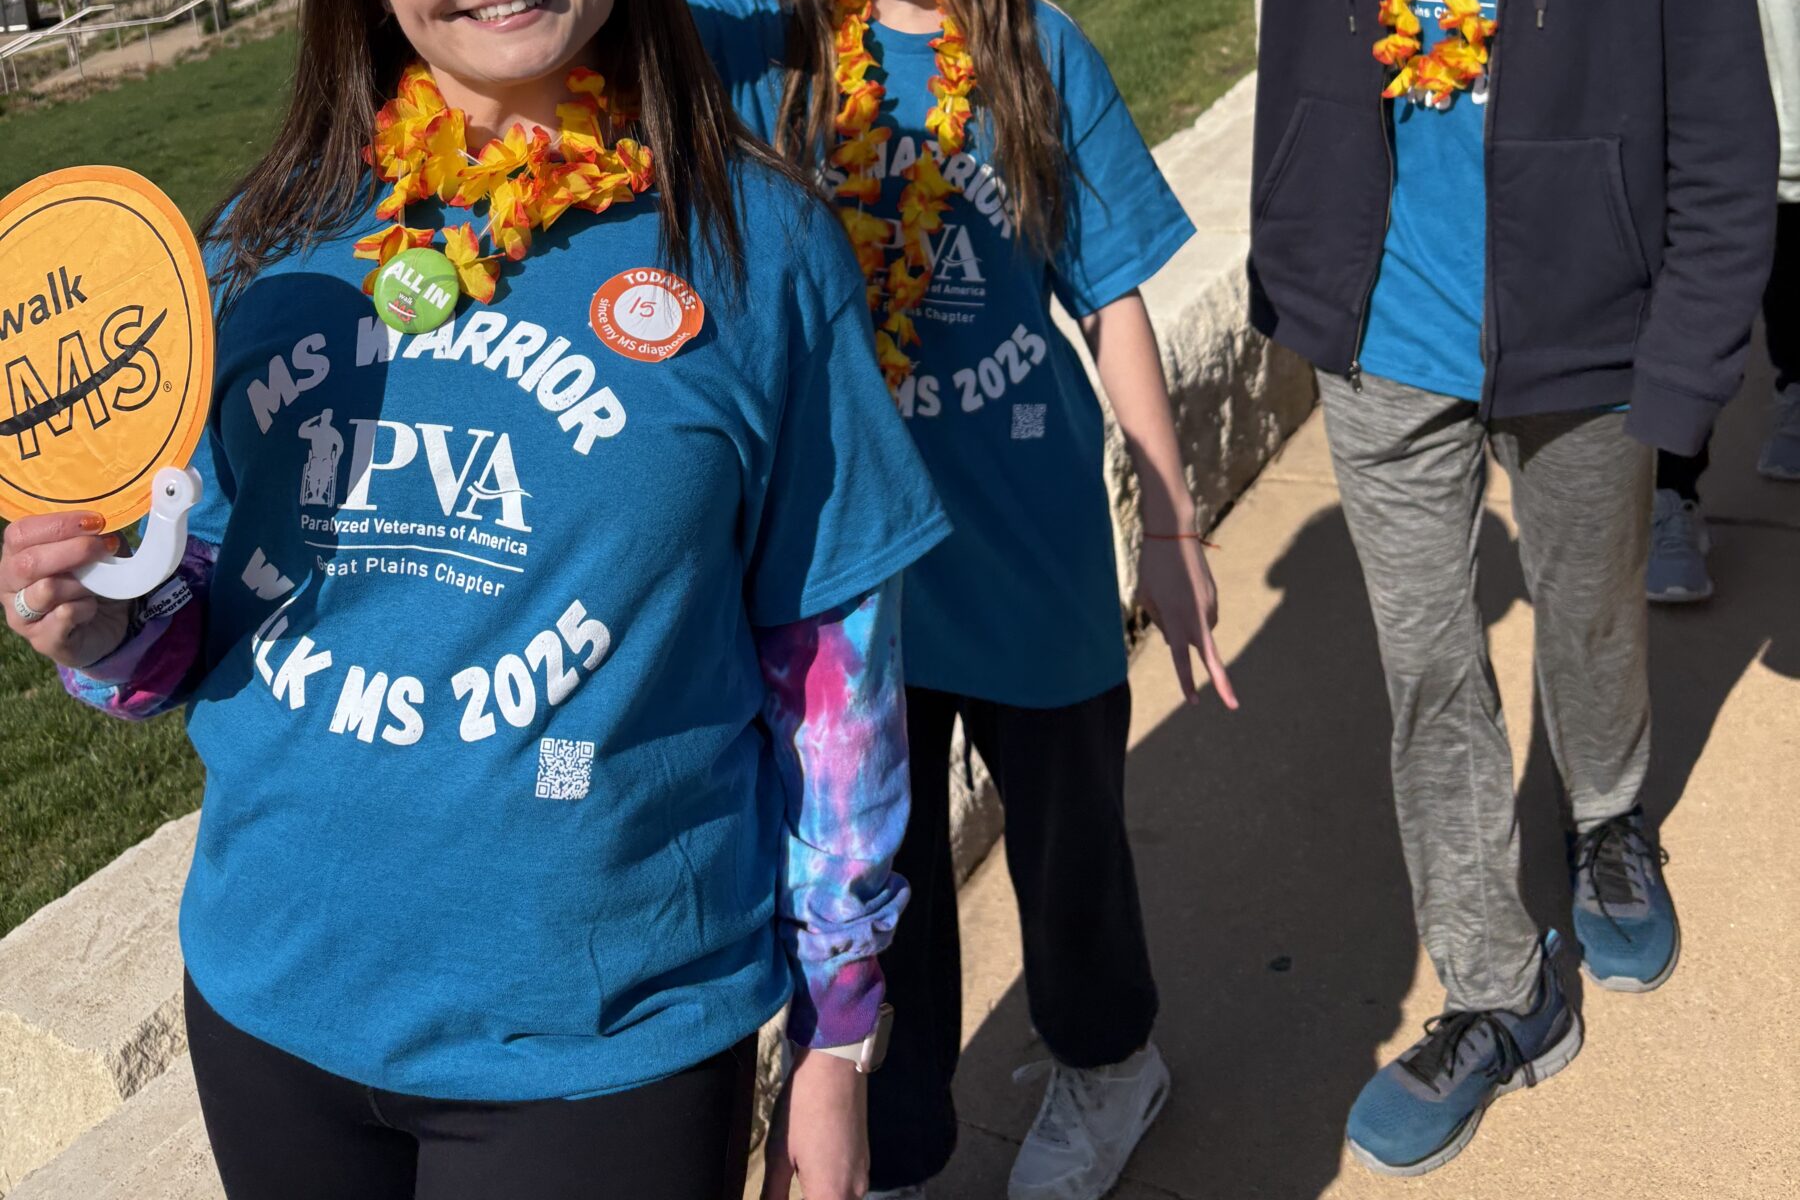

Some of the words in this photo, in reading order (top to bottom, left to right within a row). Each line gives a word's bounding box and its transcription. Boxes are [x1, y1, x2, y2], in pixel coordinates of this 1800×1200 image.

[383, 260, 424, 294] ALL
[423, 283, 452, 310] IN
[624, 271, 684, 290] TODAY
[931, 284, 942, 293] of
[943, 284, 986, 297] America
[399, 293, 413, 306] walk
[598, 297, 611, 323] since
[629, 297, 656, 318] 15
[925, 307, 976, 325] Chapter
[603, 323, 619, 340] my
[617, 336, 637, 351] MS
[953, 324, 1047, 413] 2025
[247, 334, 330, 434] MS
[356, 311, 627, 455] WARRIOR
[337, 418, 533, 533] PVA
[301, 514, 369, 536] Paralyzed
[374, 518, 446, 538] Veterans
[450, 525, 465, 540] of
[468, 527, 528, 556] America
[366, 557, 428, 577] Plains
[435, 563, 505, 597] Chapter
[329, 666, 425, 746] MS
[451, 599, 611, 743] 2025
